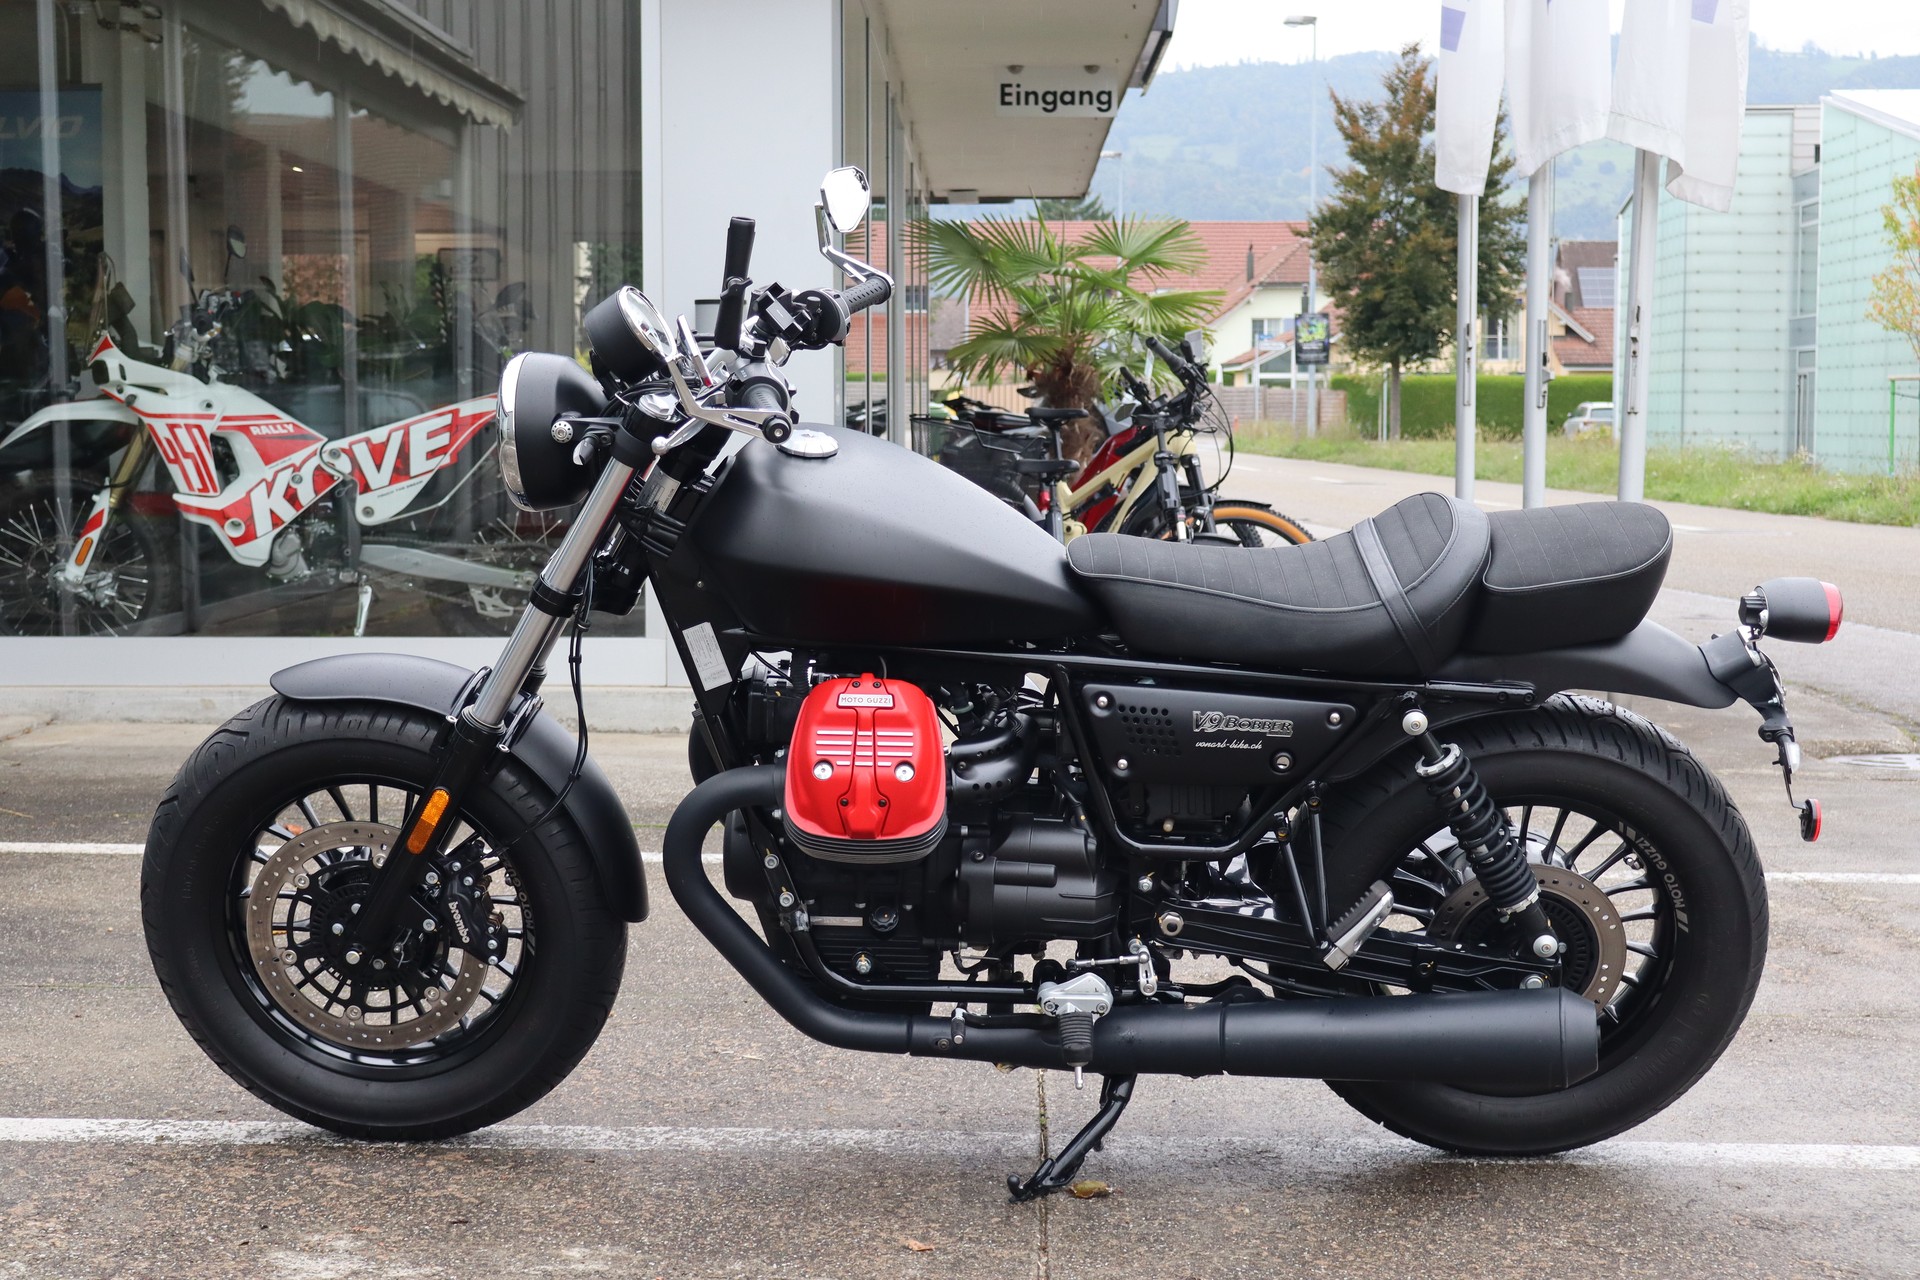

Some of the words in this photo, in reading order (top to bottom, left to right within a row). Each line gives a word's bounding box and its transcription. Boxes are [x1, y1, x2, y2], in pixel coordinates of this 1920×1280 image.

[1000, 83, 1112, 113] Eingang
[249, 423, 295, 436] RALLY
[146, 423, 219, 494] 450
[250, 413, 453, 538] KOVE
[1192, 710, 1224, 733] V9
[1223, 714, 1294, 735] BOBBER
[1195, 738, 1263, 750] vonarb-bike.ch
[1635, 836, 1668, 871] GUZZI
[1664, 873, 1687, 909] MOTO
[448, 900, 471, 944] brembo
[518, 891, 535, 929] MOTO
